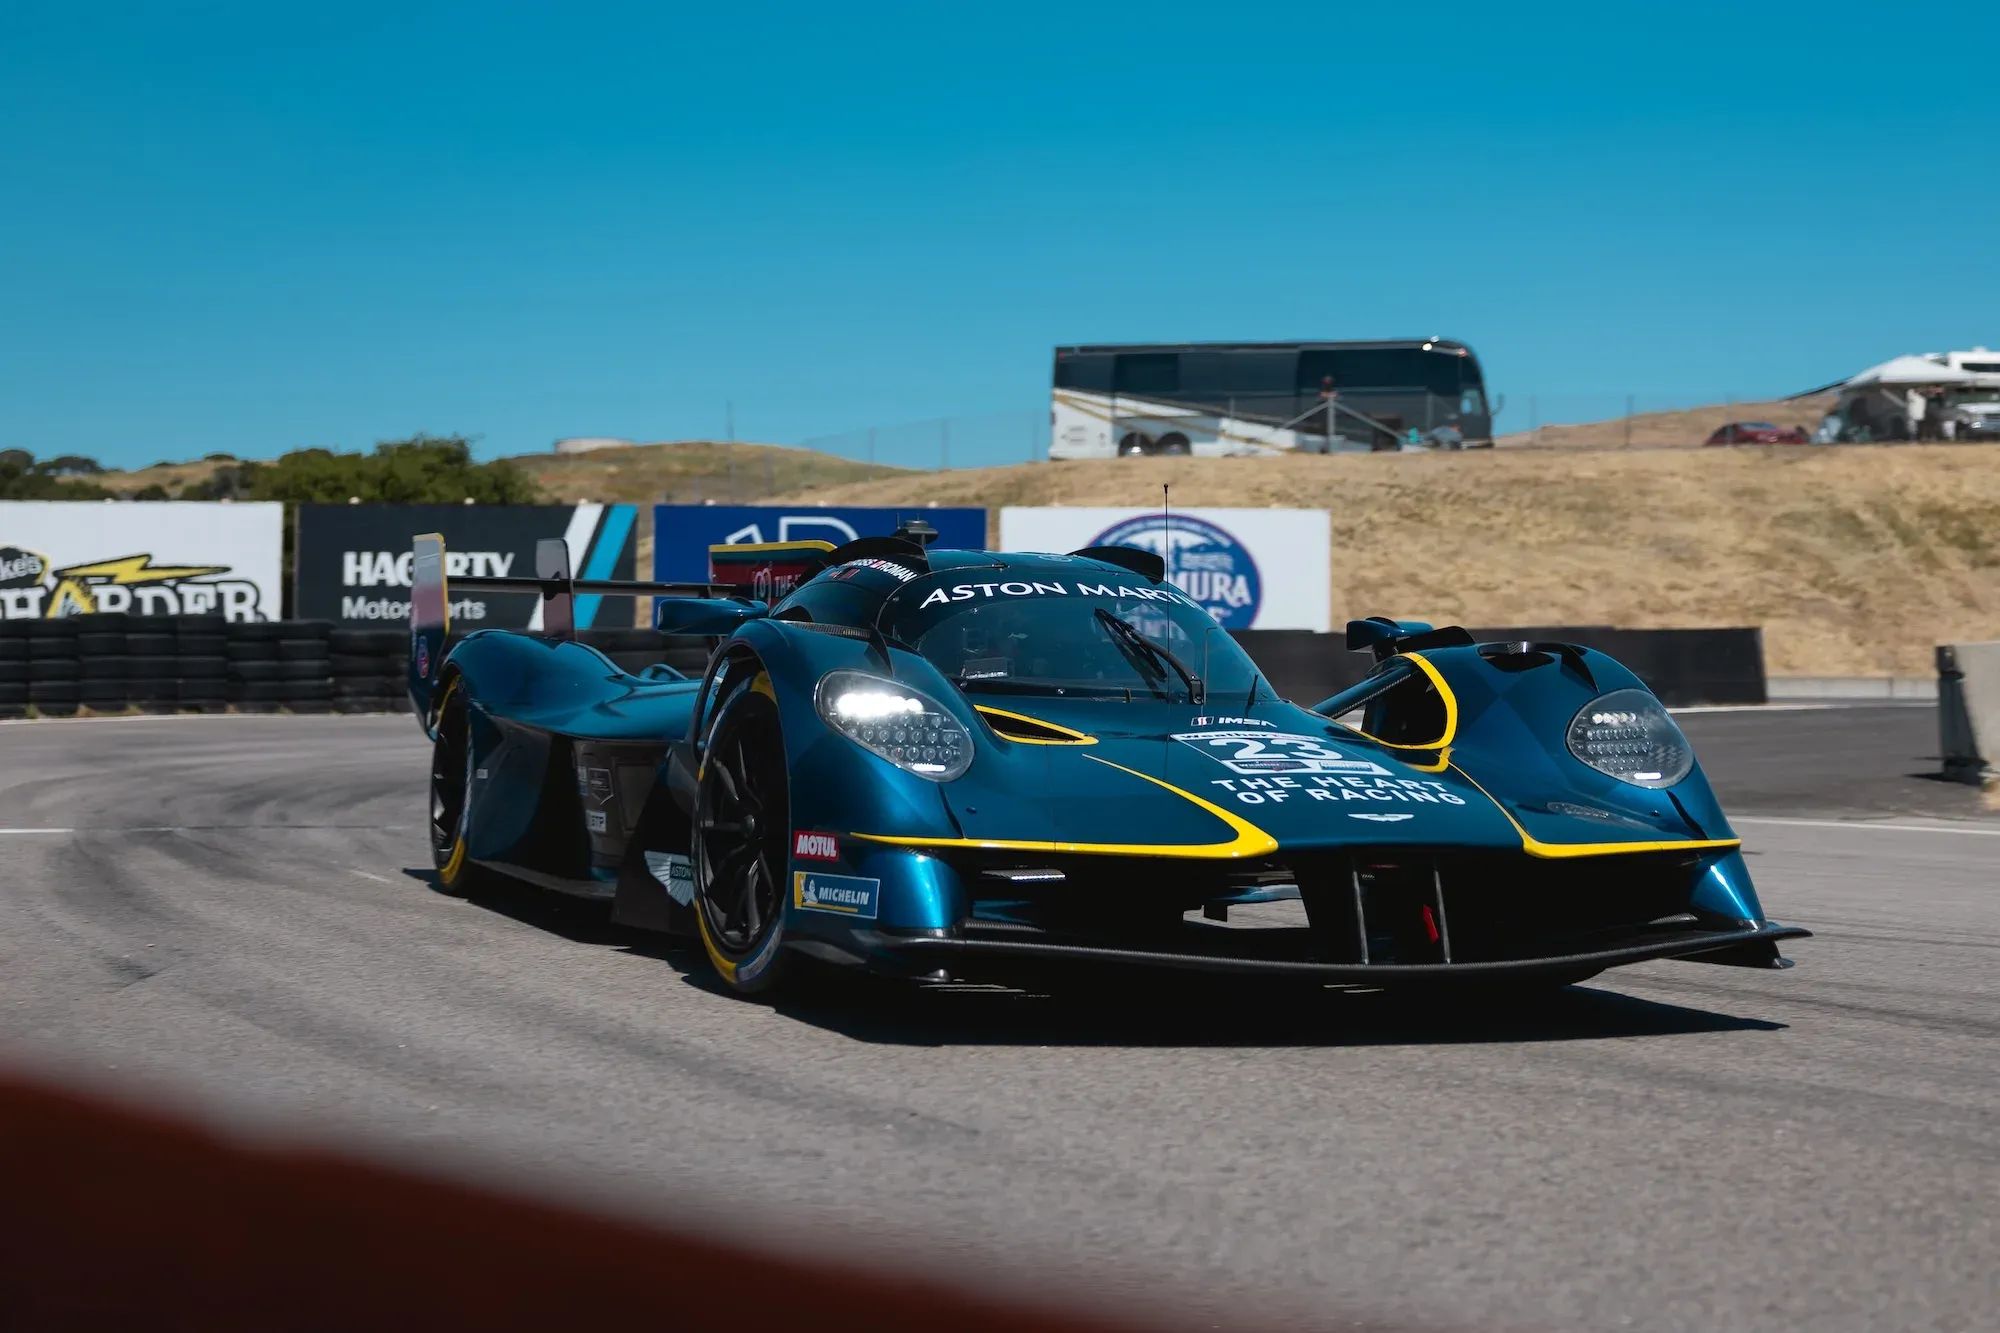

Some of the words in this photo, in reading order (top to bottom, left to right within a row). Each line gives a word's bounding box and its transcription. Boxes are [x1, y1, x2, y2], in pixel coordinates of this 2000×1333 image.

[343, 551, 515, 586] HAGRTY
[919, 582, 1067, 609] ASTON
[1208, 737, 1343, 761] 23
[1211, 776, 1303, 792] THE
[1310, 775, 1448, 793] HEART
[1236, 789, 1291, 804] OF
[1304, 787, 1466, 805] RACING
[796, 834, 837, 857] MOTUL
[818, 886, 870, 905] MICHELIN
